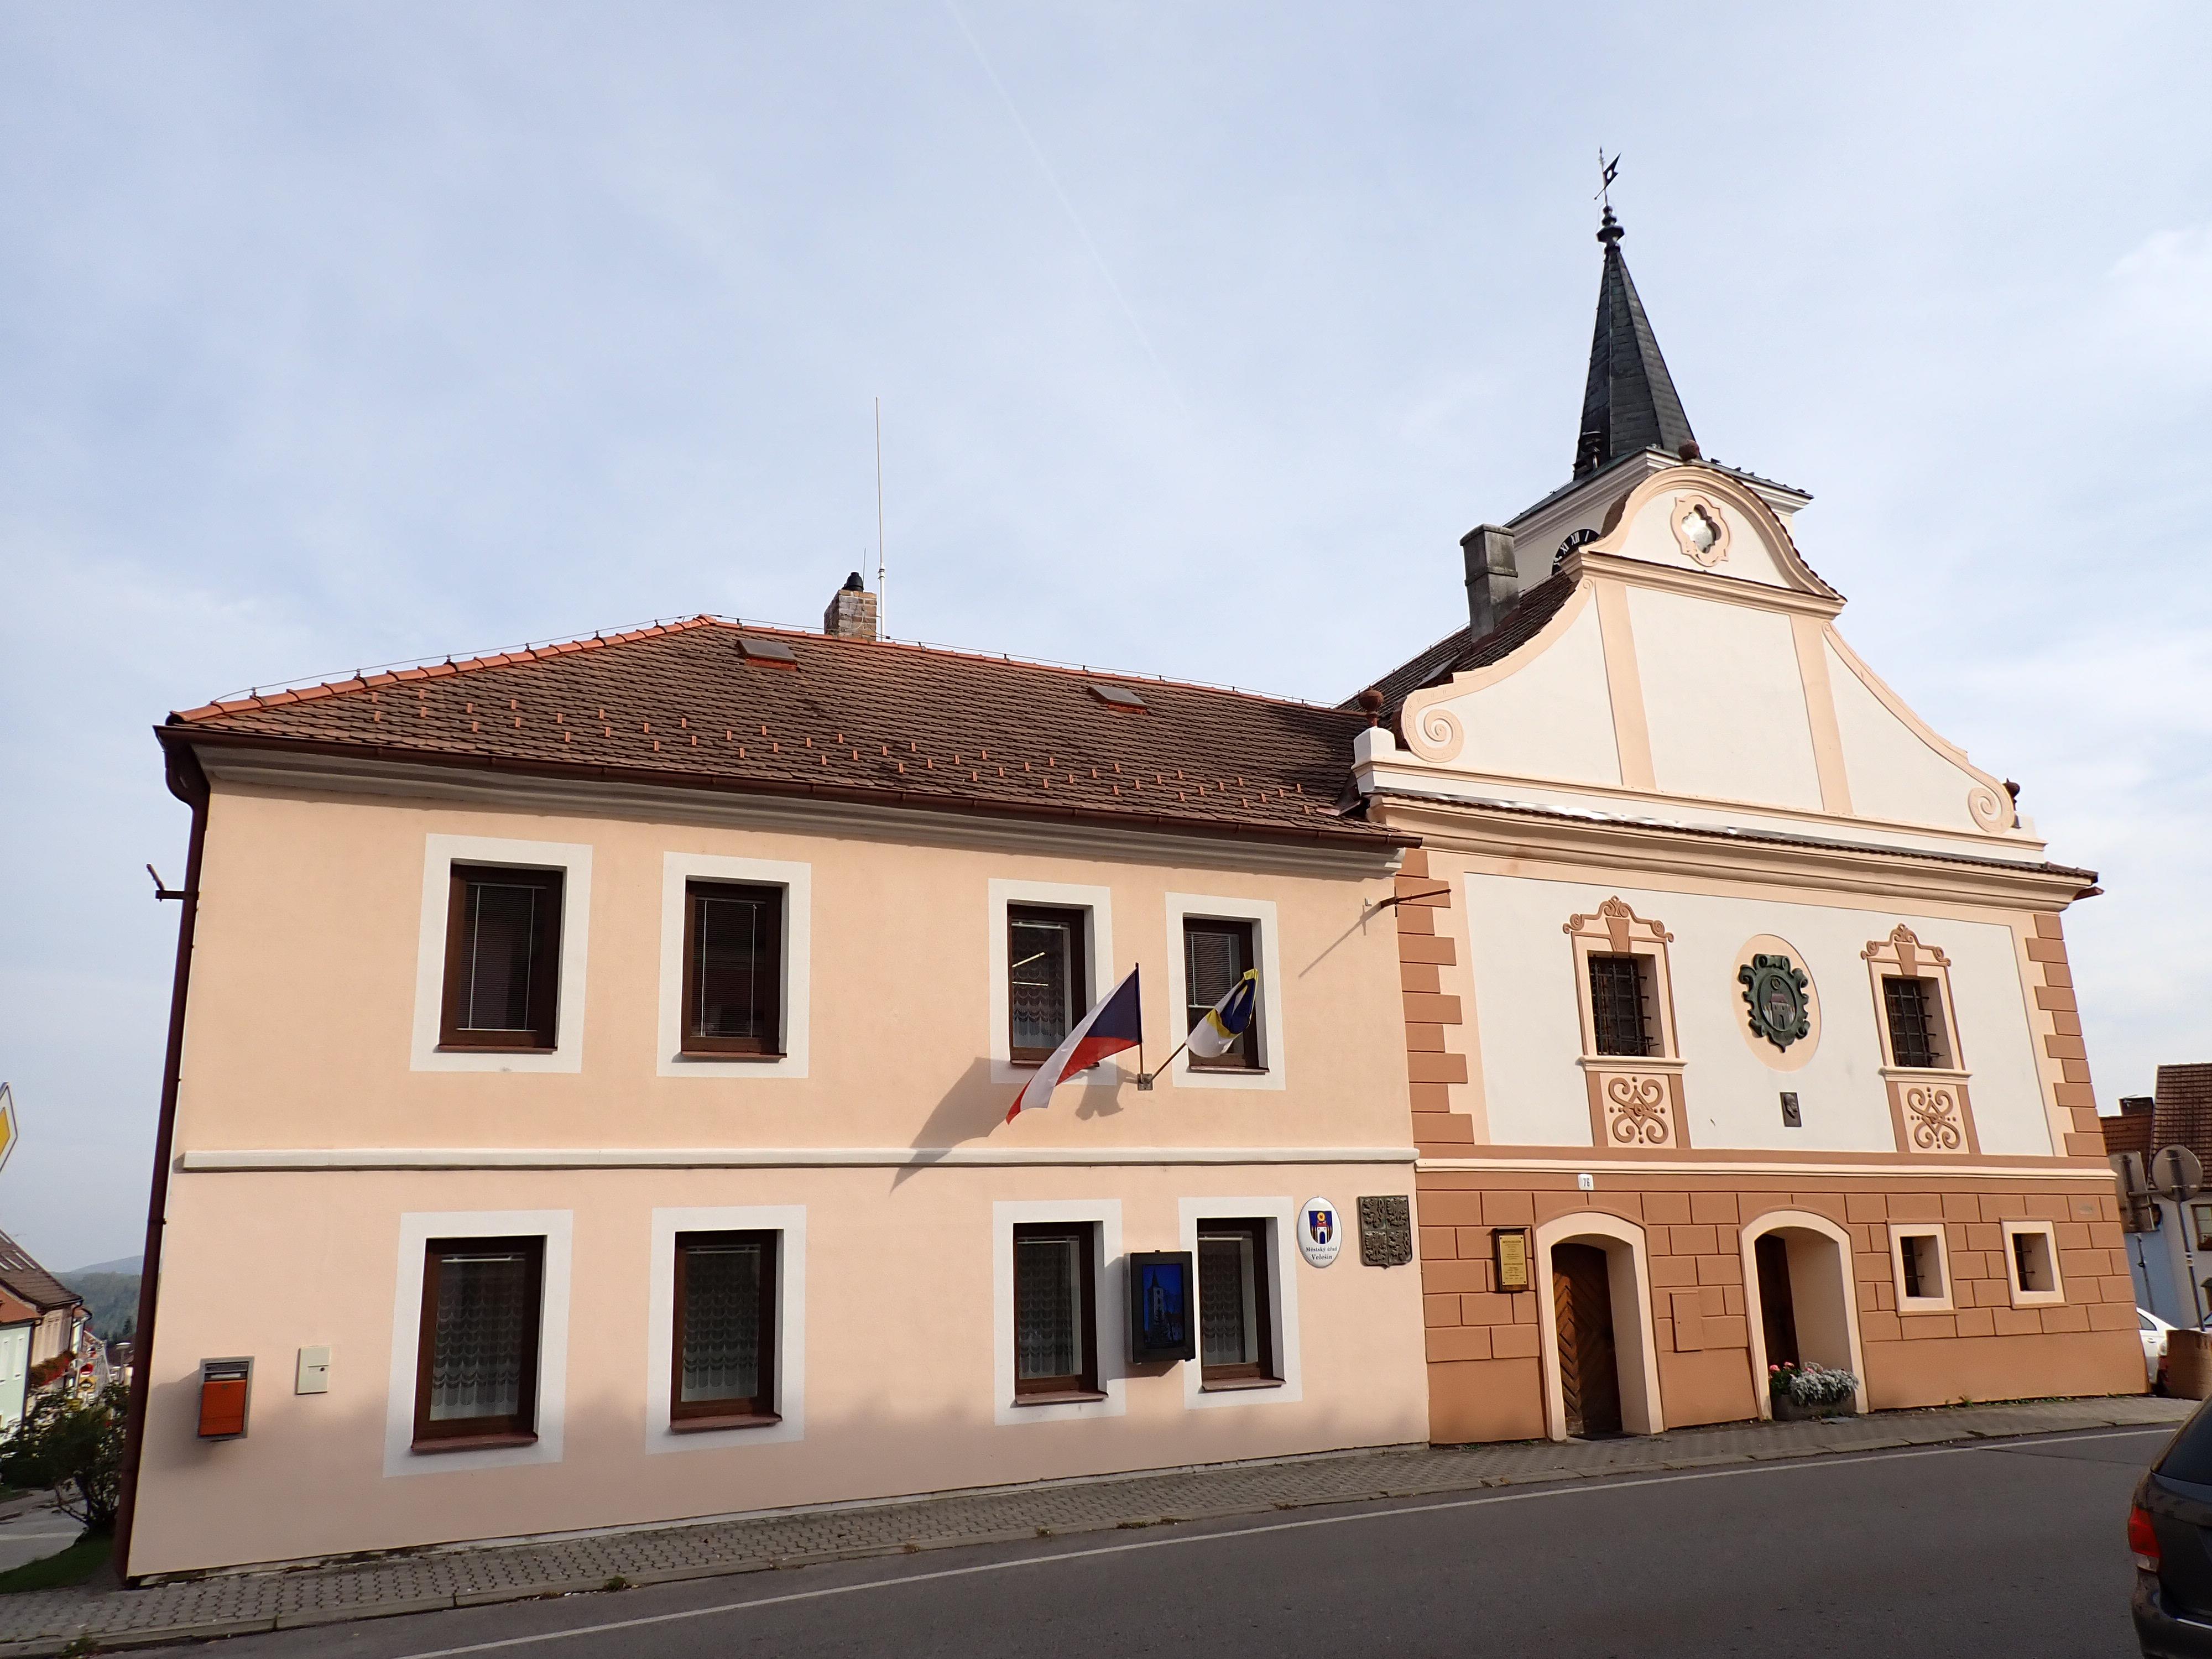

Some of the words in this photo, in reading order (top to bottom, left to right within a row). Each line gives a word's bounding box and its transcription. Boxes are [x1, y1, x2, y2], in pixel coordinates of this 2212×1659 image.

[1571, 531, 1580, 546] XII
[1560, 542, 1569, 555] XI
[1583, 1177, 1590, 1187] 76
